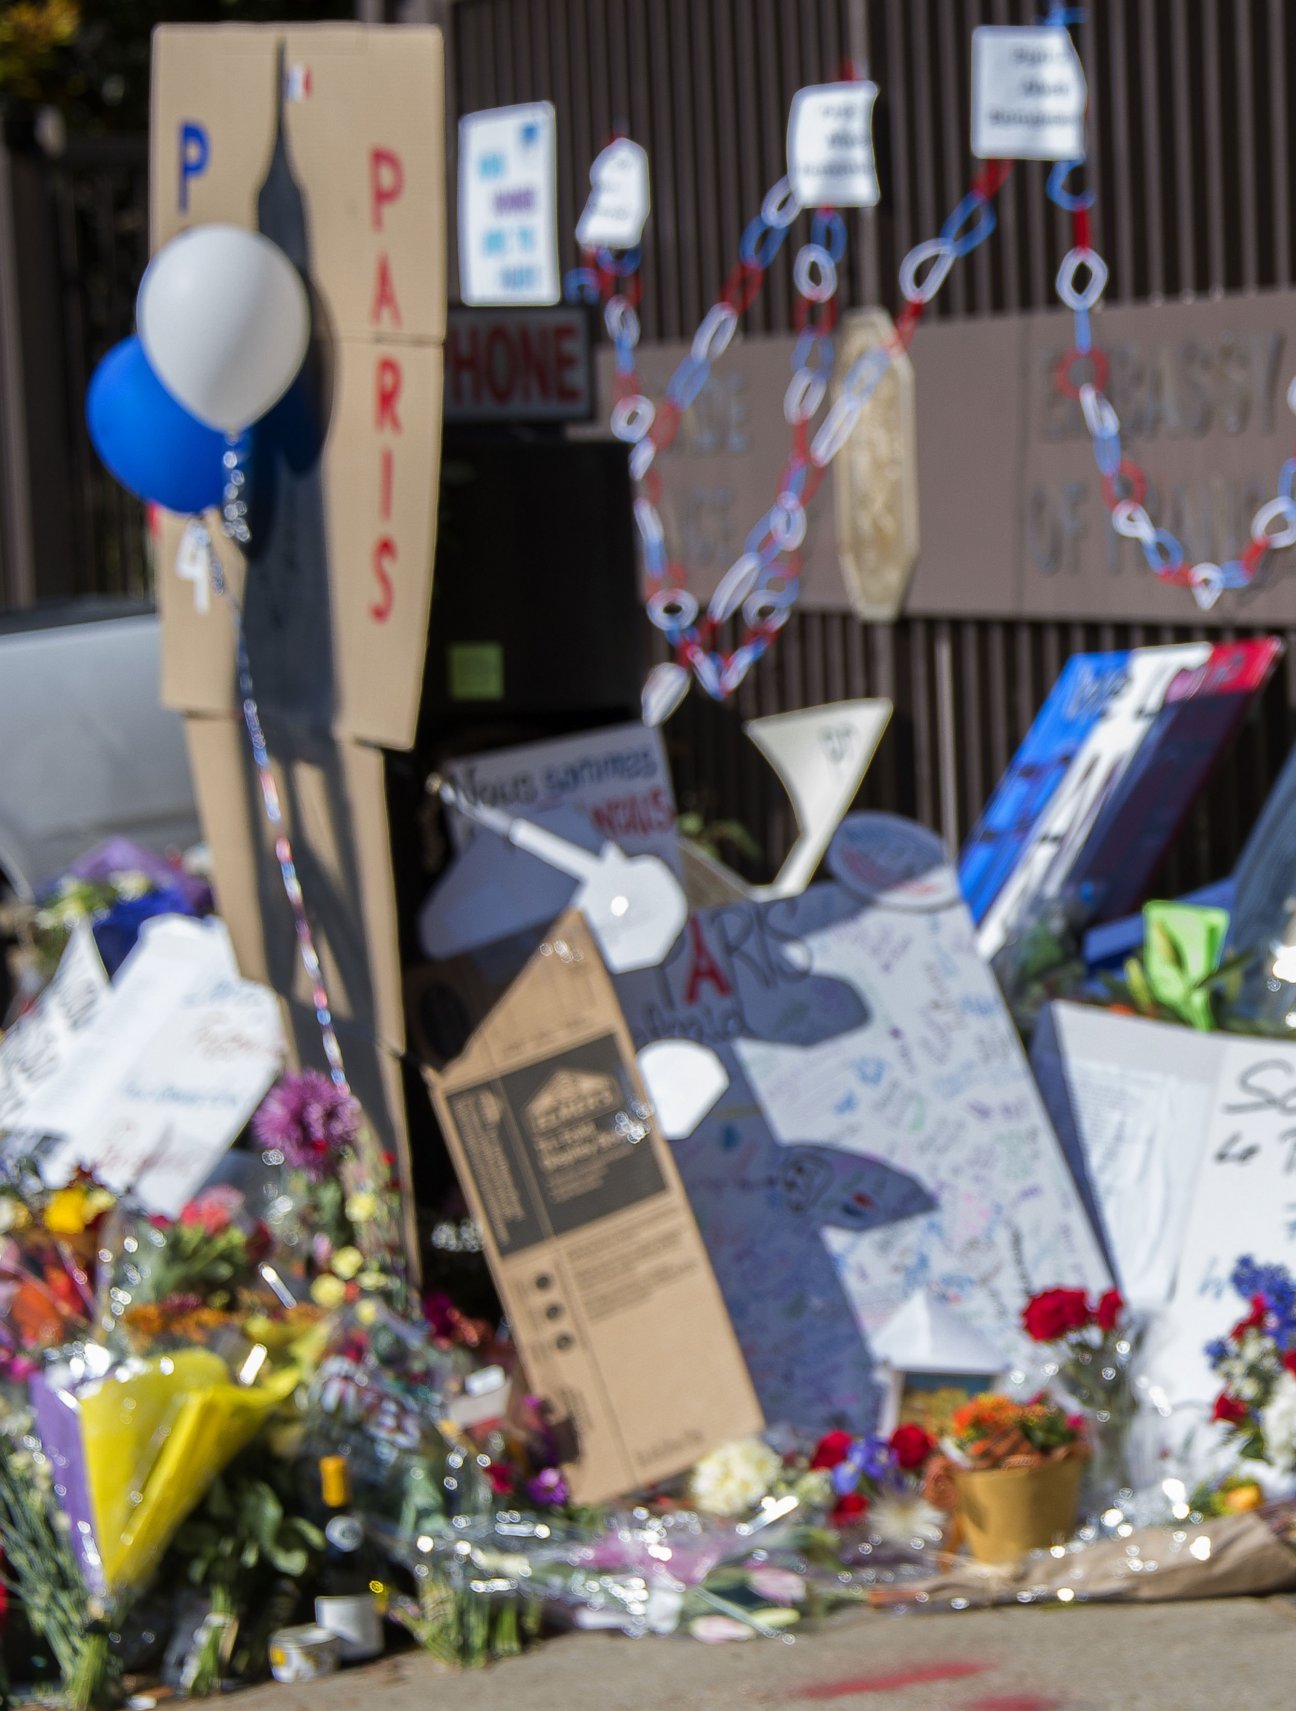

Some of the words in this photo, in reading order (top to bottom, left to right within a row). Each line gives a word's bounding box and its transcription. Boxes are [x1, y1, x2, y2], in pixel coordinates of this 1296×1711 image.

[369, 145, 405, 625] PARIS
[443, 322, 582, 406] HONE
[1041, 333, 1286, 442] EBASSY
